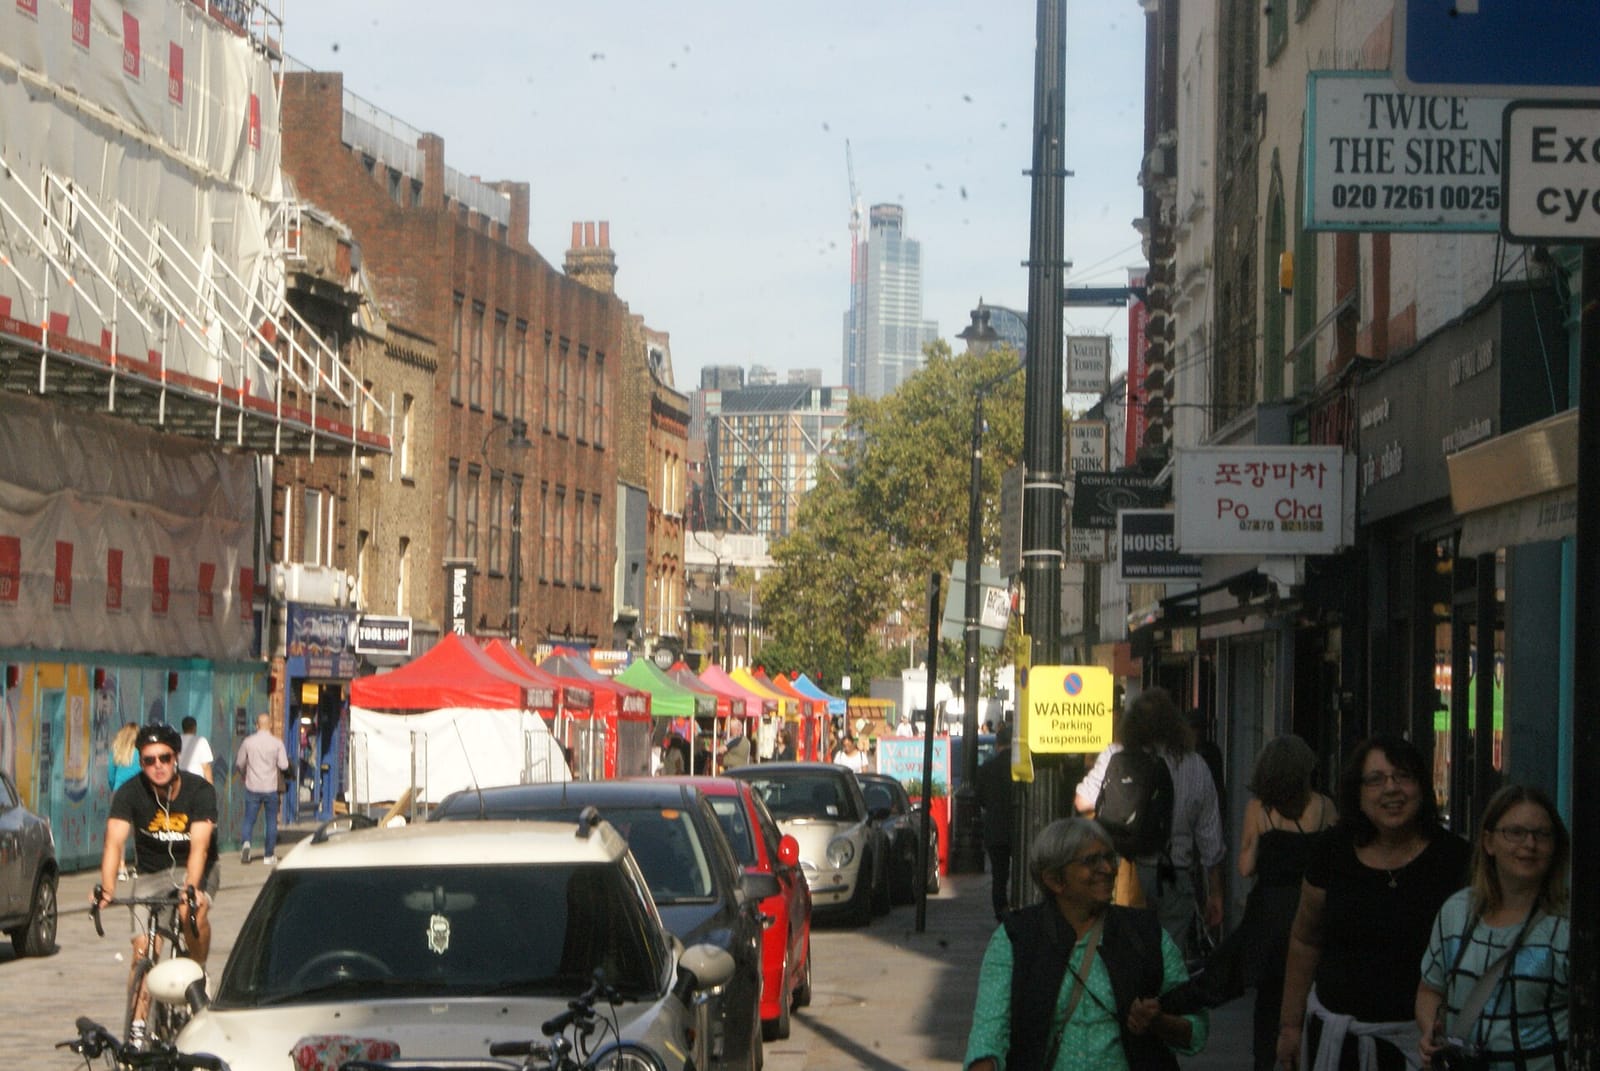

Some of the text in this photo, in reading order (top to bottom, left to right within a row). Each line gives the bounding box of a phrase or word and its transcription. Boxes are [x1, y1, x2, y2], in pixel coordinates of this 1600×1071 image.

[1363, 93, 1469, 130] TWICE
[1329, 137, 1395, 174] THE
[1332, 184, 1500, 209] 020 7261 0025
[1081, 476, 1120, 486] CONTACT
[1215, 461, 1328, 489] 포장마차
[1217, 498, 1323, 520] Po Cha
[1124, 534, 1174, 552] HOUSE
[359, 627, 409, 641] TOOL SHOP
[1034, 702, 1106, 717] WARNING
[1051, 719, 1093, 734] Parking
[1039, 733, 1102, 748] suspension
